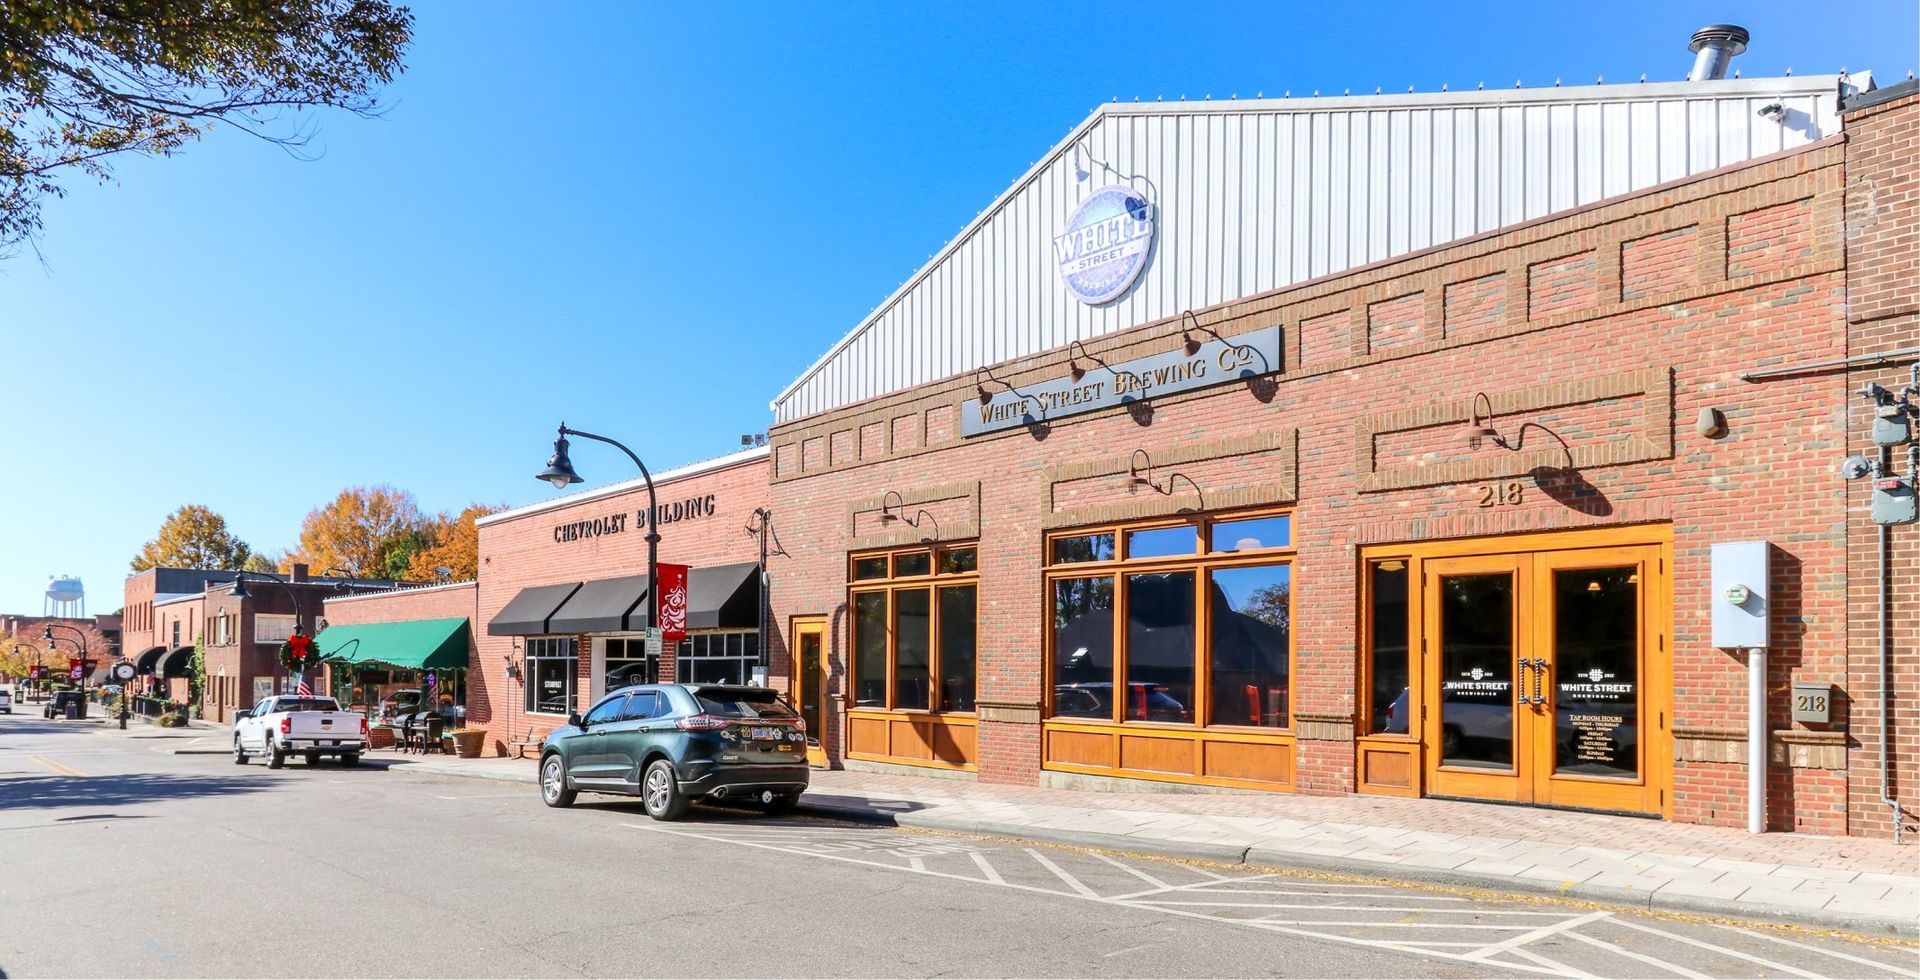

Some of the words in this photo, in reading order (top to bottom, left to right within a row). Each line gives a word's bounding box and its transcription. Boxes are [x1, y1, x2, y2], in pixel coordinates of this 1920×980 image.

[1053, 208, 1150, 264] WHITE
[1079, 247, 1125, 269] STREET
[979, 400, 1030, 424] WHITE
[1038, 382, 1105, 411] STREET
[1113, 359, 1207, 395] BREWING
[1479, 482, 1523, 508] 218
[554, 513, 627, 543] CHEVROLET
[636, 494, 716, 528] BILDING
[1447, 681, 1474, 690] WHITE
[1475, 682, 1508, 690] STREET
[1561, 683, 1593, 692] WHITE
[1593, 684, 1632, 693] STREET
[1798, 695, 1826, 712] 218
